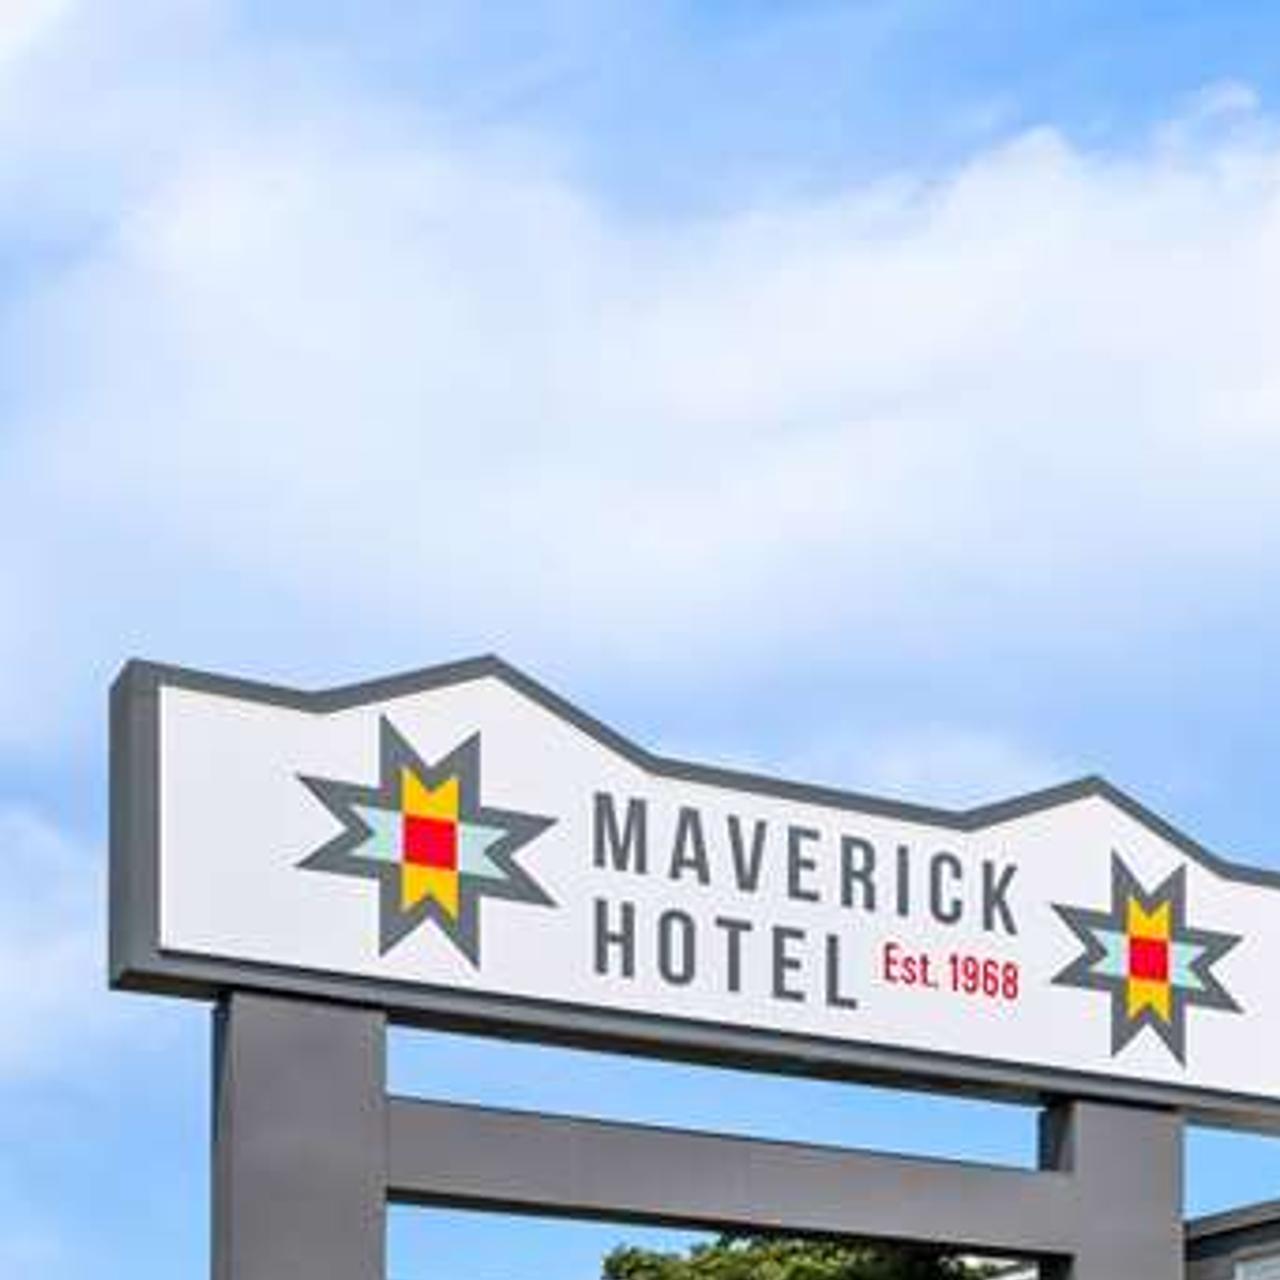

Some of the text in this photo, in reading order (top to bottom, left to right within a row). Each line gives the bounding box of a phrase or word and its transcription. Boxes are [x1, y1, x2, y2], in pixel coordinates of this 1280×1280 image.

[593, 791, 1018, 936] MAVERICK
[594, 897, 858, 1011] HOTEL
[883, 941, 1019, 1001] Est. 1968
